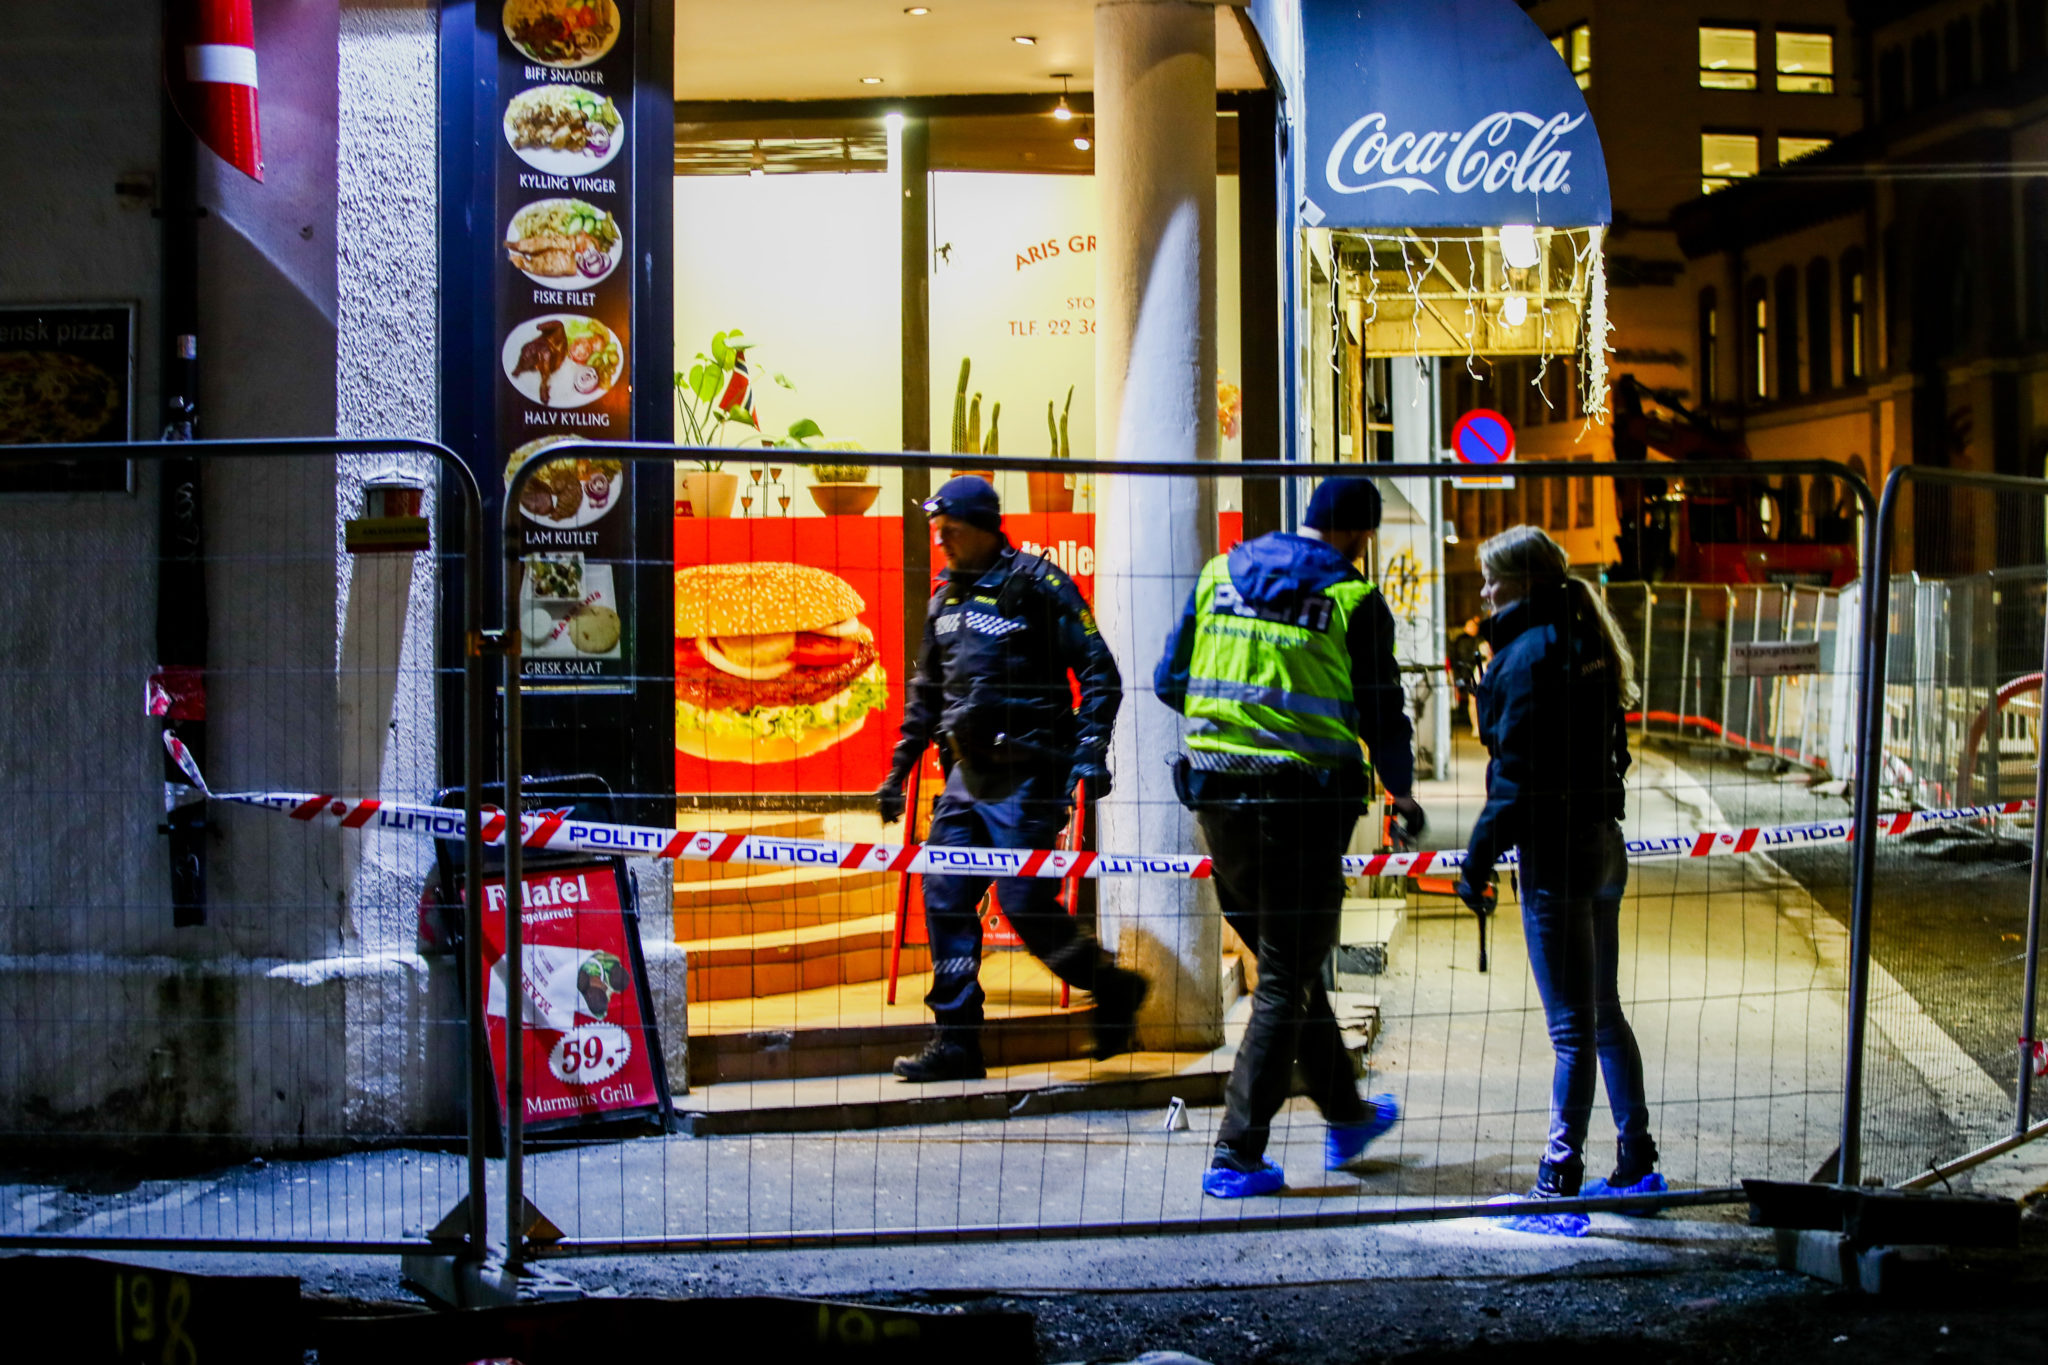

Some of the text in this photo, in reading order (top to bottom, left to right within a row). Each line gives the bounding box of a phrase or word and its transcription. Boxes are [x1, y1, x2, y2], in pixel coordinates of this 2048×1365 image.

[524, 66, 604, 85] BIFF SNADDER
[1325, 111, 1587, 195] Coca-Cola
[519, 174, 616, 193] KYLLING VINGER
[1015, 235, 1096, 271] ARIS GR
[533, 290, 596, 307] FISKE FILET
[1066, 296, 1095, 310] STO
[56, 319, 115, 348] pizza
[1048, 320, 1071, 335] 22
[524, 411, 610, 427] HALV KYLLING
[525, 531, 599, 546] LAM KUTLET
[525, 661, 602, 675] GRESK SALAT
[569, 826, 662, 848] POLITI
[1764, 824, 1845, 845] POLITI
[746, 843, 838, 864] POLITI
[1626, 837, 1692, 853] OLITI
[928, 850, 1020, 867] POLITI
[1100, 859, 1190, 874] POLITI
[484, 873, 590, 912] Flafel
[525, 1083, 635, 1115] Marmaris Grill
